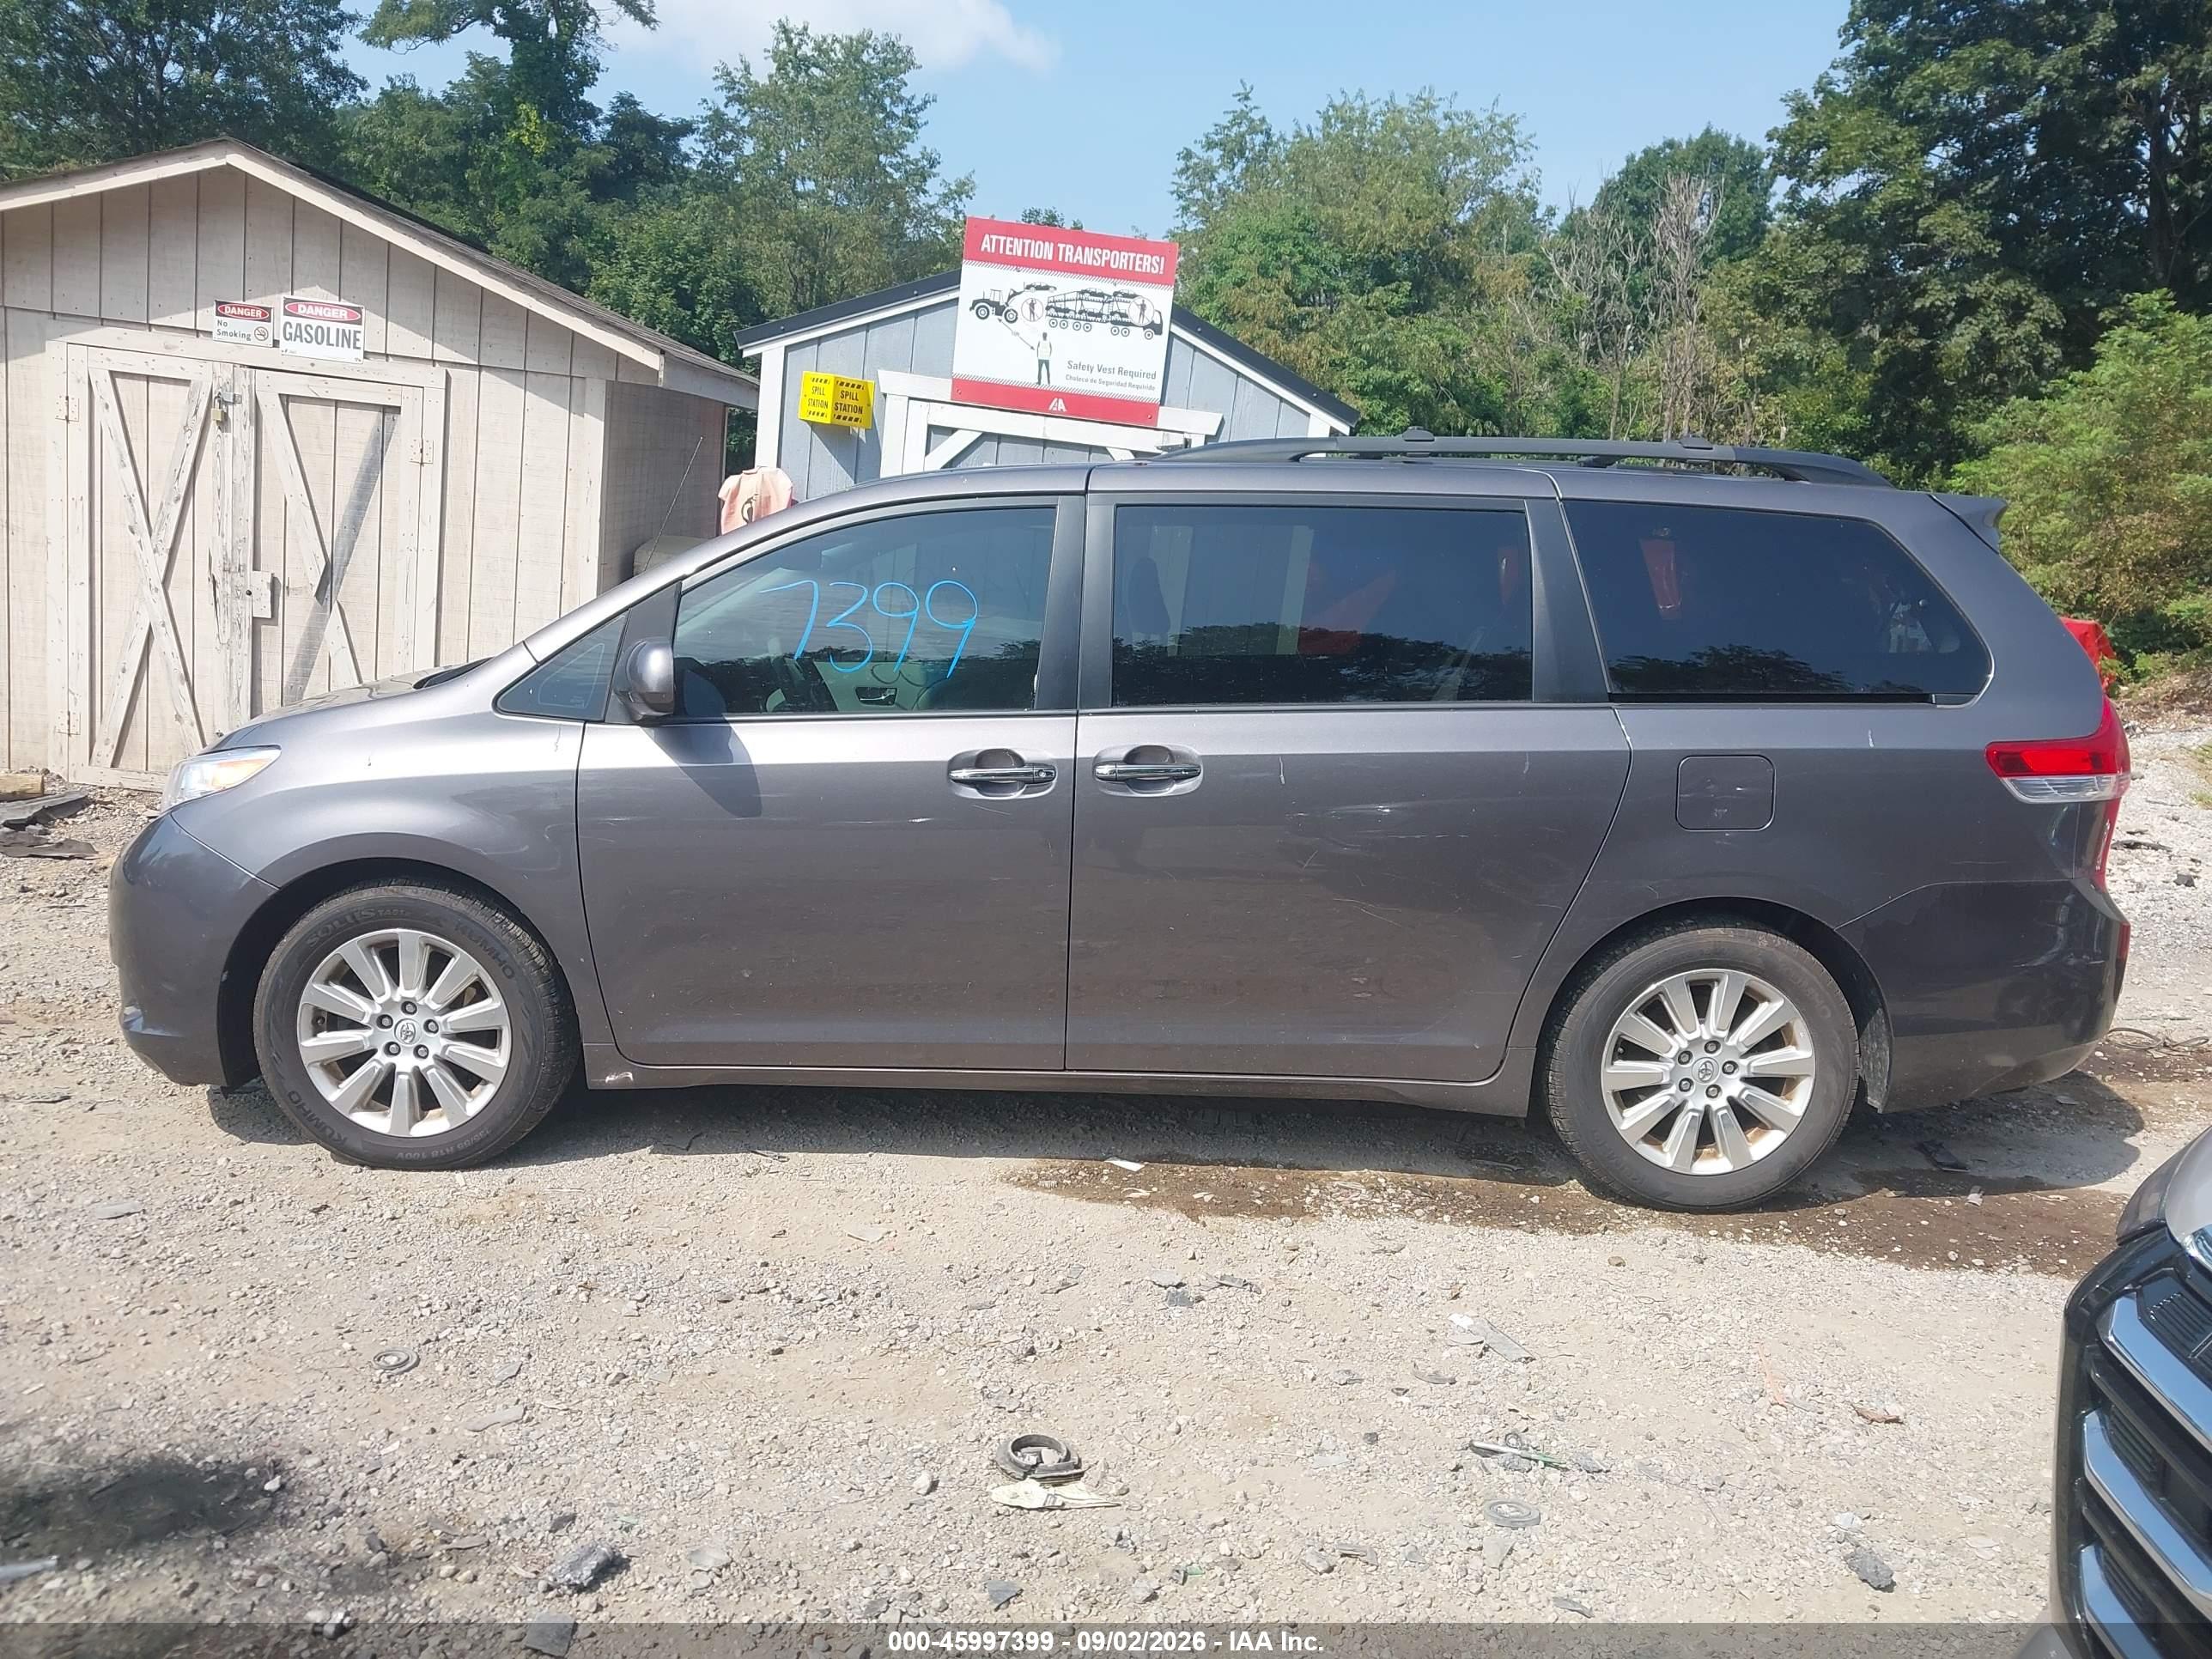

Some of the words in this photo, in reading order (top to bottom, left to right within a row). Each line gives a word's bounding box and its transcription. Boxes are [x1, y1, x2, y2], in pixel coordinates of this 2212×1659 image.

[981, 234, 1054, 261] ATTENTION
[1058, 243, 1165, 275] TRANSPORTERS!
[224, 306, 263, 318] DANGER
[298, 304, 349, 319] DANGER
[216, 328, 252, 342] Smoking
[283, 321, 362, 350] GASOLINE
[1066, 360, 1095, 374] Safety
[1097, 363, 1115, 375] Vest
[1117, 366, 1157, 380] Required
[811, 386, 825, 396] SPILL
[840, 390, 860, 401] SPILL
[807, 398, 829, 410] STATION
[834, 402, 864, 415] STATION
[759, 579, 979, 678] 7399
[286, 1091, 348, 1146] KUMHO
